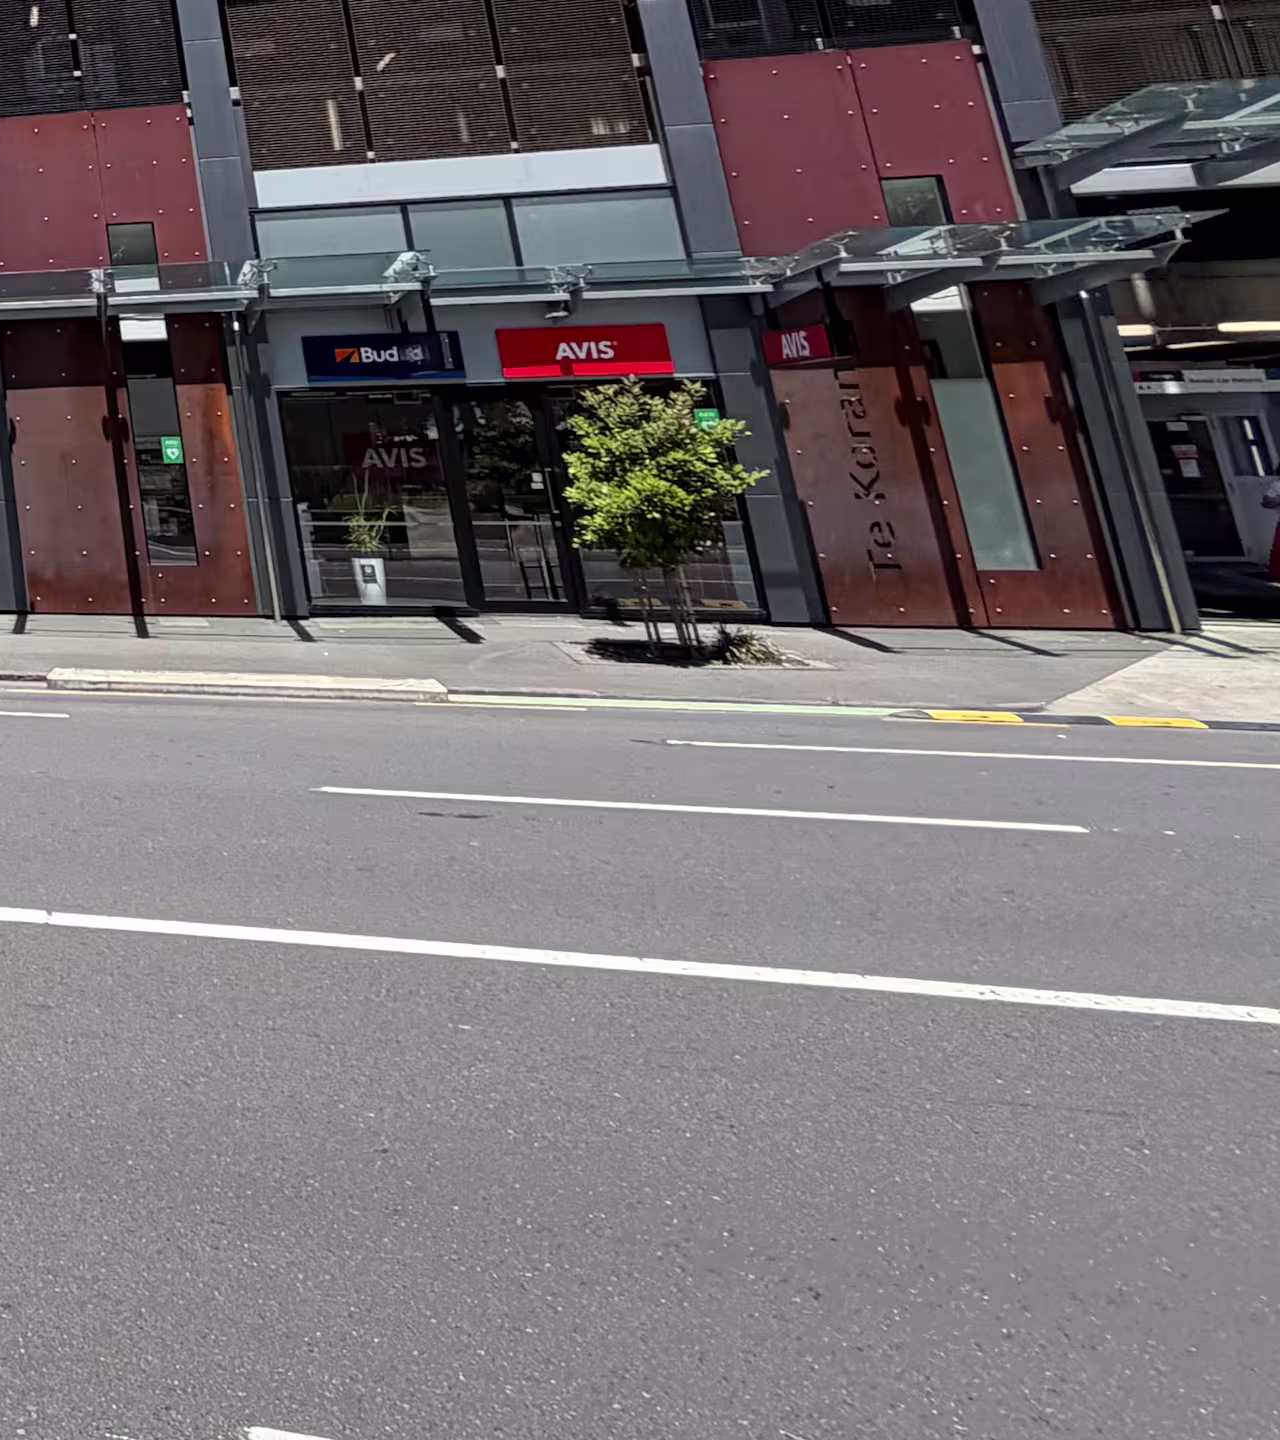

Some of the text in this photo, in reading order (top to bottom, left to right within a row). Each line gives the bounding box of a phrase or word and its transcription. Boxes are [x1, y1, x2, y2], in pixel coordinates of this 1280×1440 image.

[555, 340, 615, 360] AVIS
[781, 331, 810, 359] AVIS
[362, 447, 428, 469] AVIS
[866, 520, 902, 575] Te
